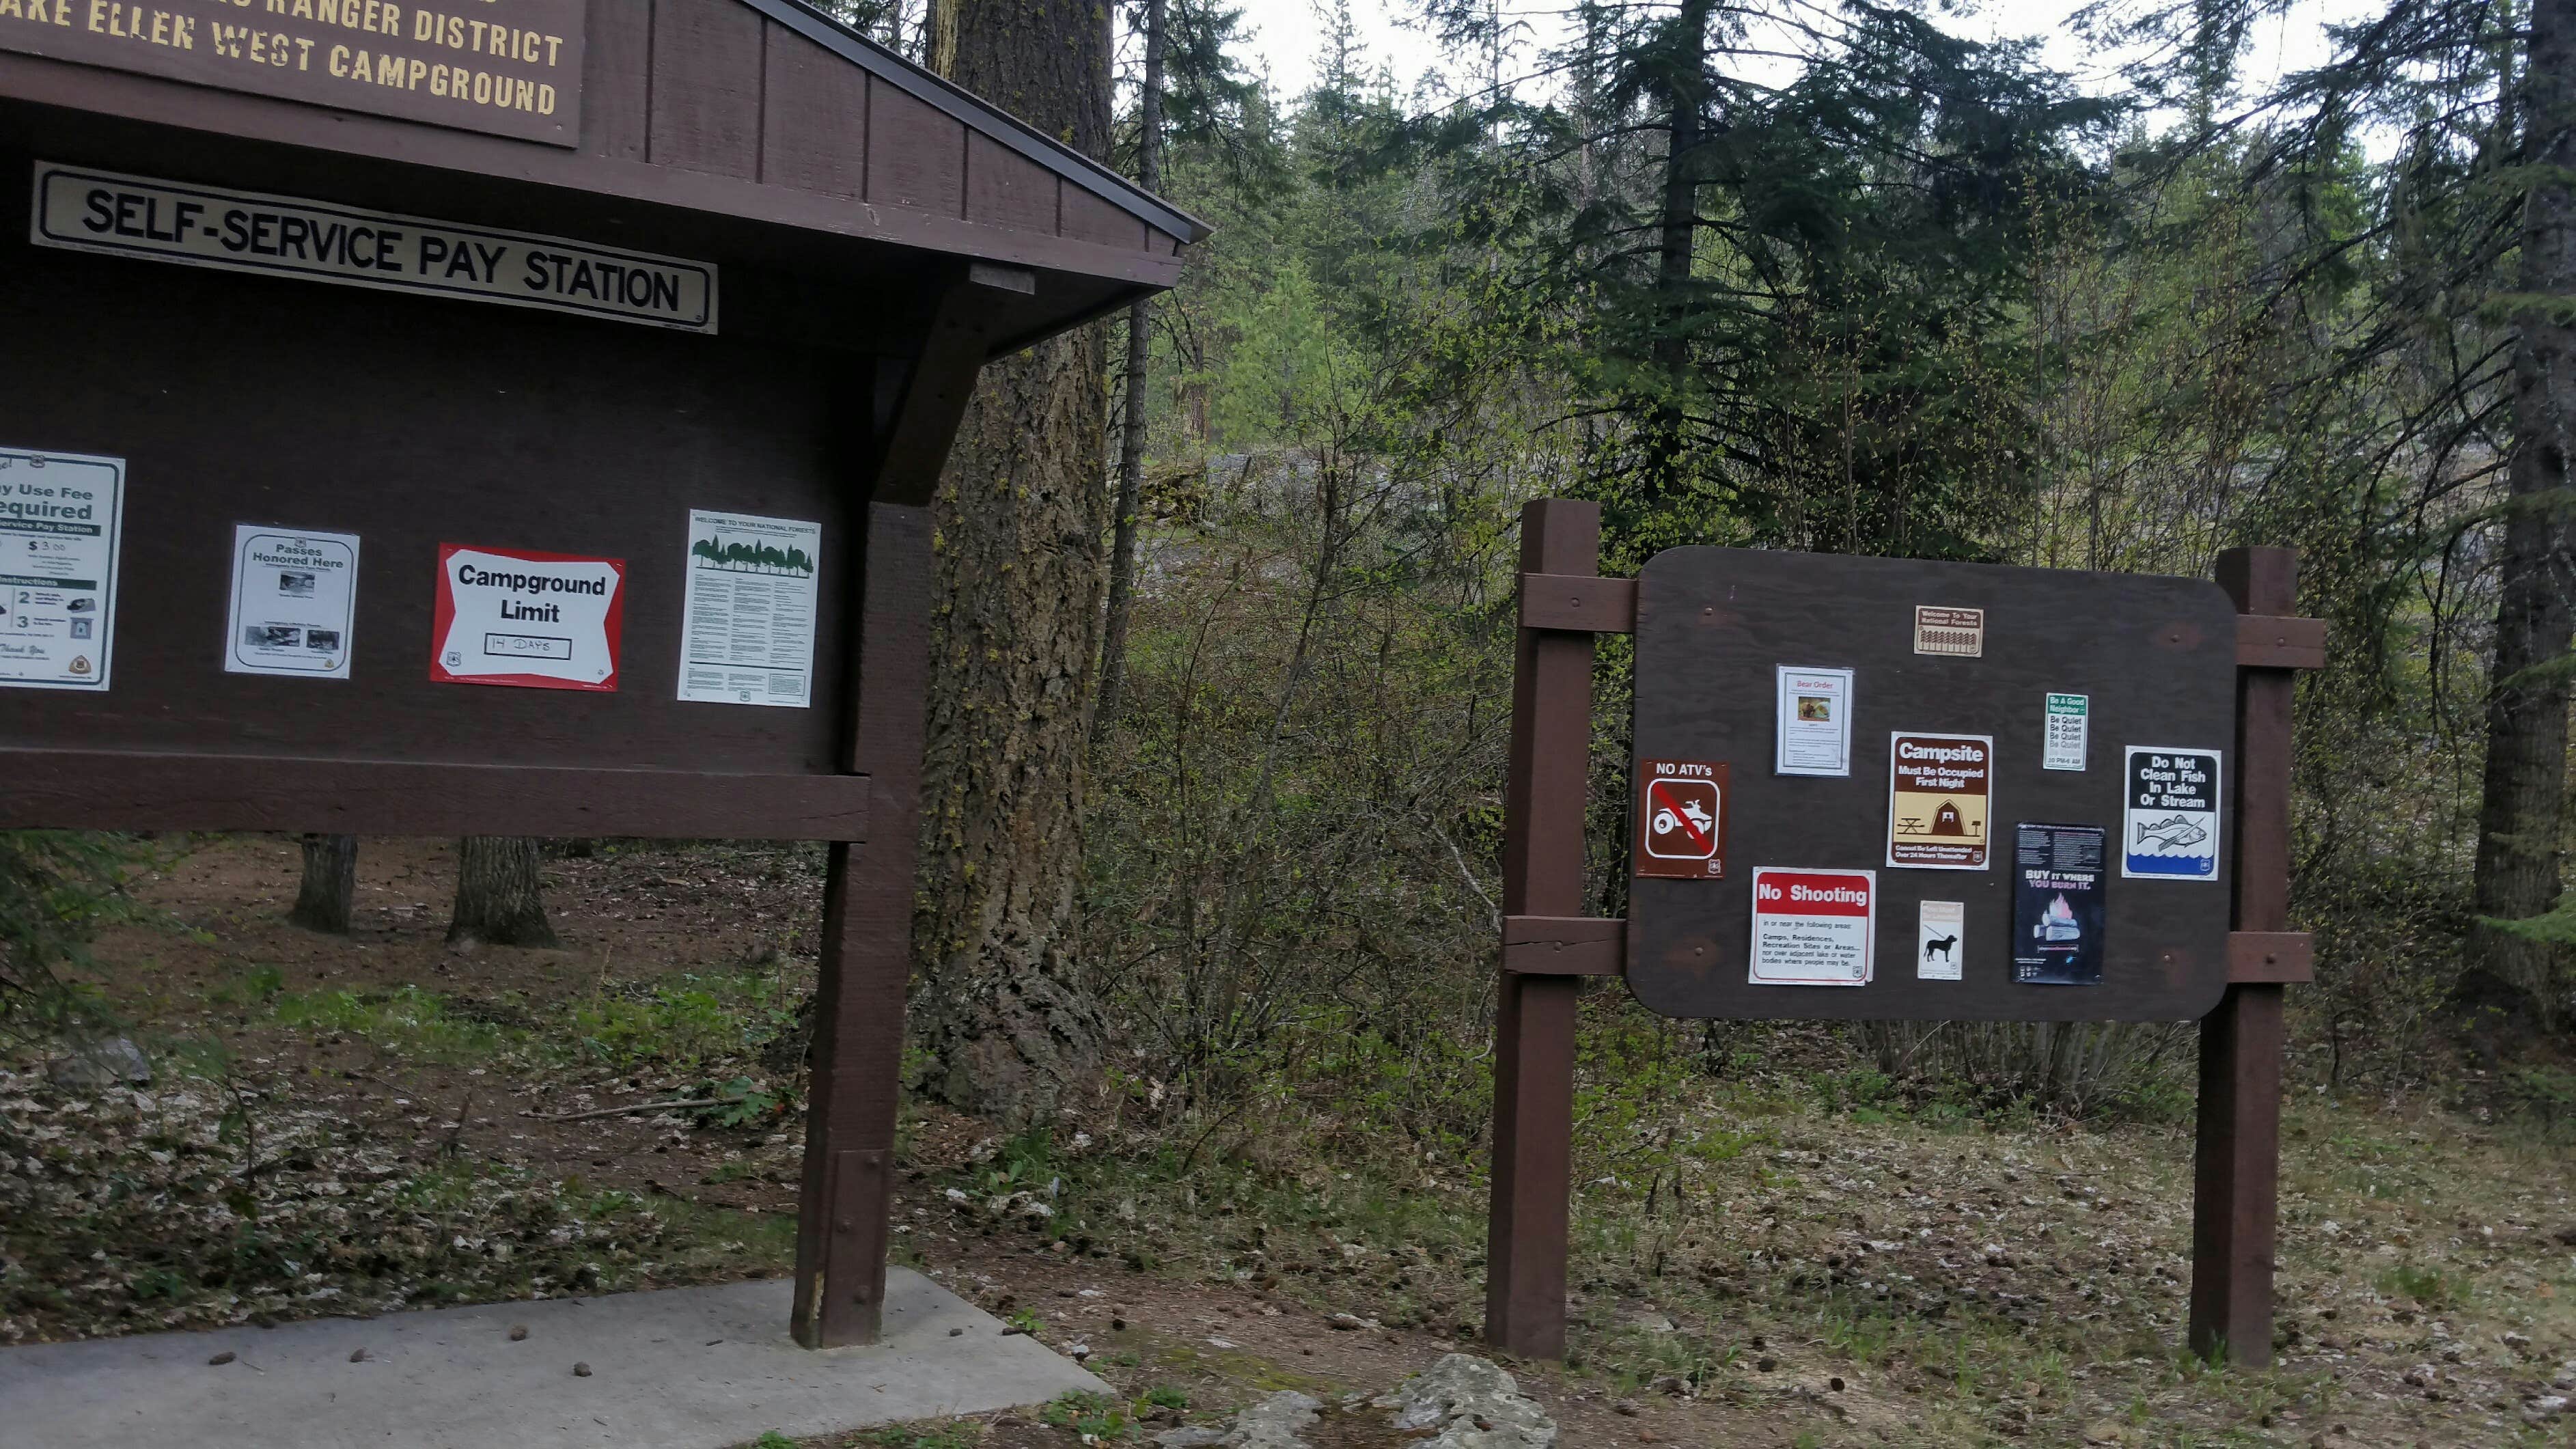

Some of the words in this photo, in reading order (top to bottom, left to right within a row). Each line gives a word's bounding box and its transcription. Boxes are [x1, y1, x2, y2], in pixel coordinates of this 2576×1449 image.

[414, 10, 564, 67] DISTRICT
[0, 0, 71, 27] AKE
[87, 0, 195, 50] ELLEN
[212, 21, 315, 71] WEST
[329, 44, 555, 115] CAMPGROUND
[82, 189, 403, 272] SELF-SERVICE
[419, 235, 508, 284] PAY
[523, 251, 680, 312] STATION
[19, 484, 55, 497] Use
[61, 487, 94, 500] Fee
[0, 501, 92, 520] quired
[36, 523, 55, 532] Pay
[57, 524, 93, 534] Station
[695, 516, 727, 525] WELCOME
[757, 523, 788, 532] NATIONAL
[788, 526, 816, 534] FORESTS
[276, 544, 322, 556] Passes
[253, 552, 308, 565] Honored
[313, 557, 344, 568] Here
[458, 564, 606, 596] Campground
[18, 592, 30, 604] 2
[501, 599, 560, 623] Limit
[16, 616, 29, 628] 3
[491, 638, 505, 650] 14
[513, 638, 551, 651] DAYS
[1814, 681, 1833, 689] Order
[2049, 696, 2059, 704] Be
[2066, 698, 2084, 706] Good
[2049, 704, 2079, 715] Neighbor
[2050, 715, 2060, 723] Be
[2062, 716, 2081, 725] Quiet
[2061, 724, 2081, 732] Quiet
[2061, 732, 2081, 741] Quiet
[2060, 741, 2081, 749] Quiet
[1898, 742, 1984, 764] Campsite
[1656, 762, 1676, 775] NO
[1678, 764, 1713, 776] ATV's
[2152, 756, 2170, 768] Do
[2174, 757, 2196, 770] Not
[1898, 765, 1922, 775] Must
[1923, 766, 1937, 776] Be
[1937, 767, 1984, 779] Occupied
[2139, 768, 2176, 782] Clean
[2180, 770, 2206, 784] Fish
[1915, 777, 1938, 787] First
[1938, 778, 1965, 789] Night
[2149, 781, 2162, 794] In
[2166, 782, 2196, 795] Lake
[2139, 793, 2156, 806] Or
[2161, 794, 2206, 808] Stream
[2025, 870, 2050, 880] BUY
[2062, 873, 2094, 882] WHERE
[2029, 879, 2049, 888] YOU
[2051, 881, 2077, 889] BURN
[1758, 883, 1782, 900] No
[1790, 884, 1867, 907] Shooting
[1807, 921, 1832, 929] following
[1763, 933, 1789, 941] Camps,
[1792, 934, 1834, 942] Residences,
